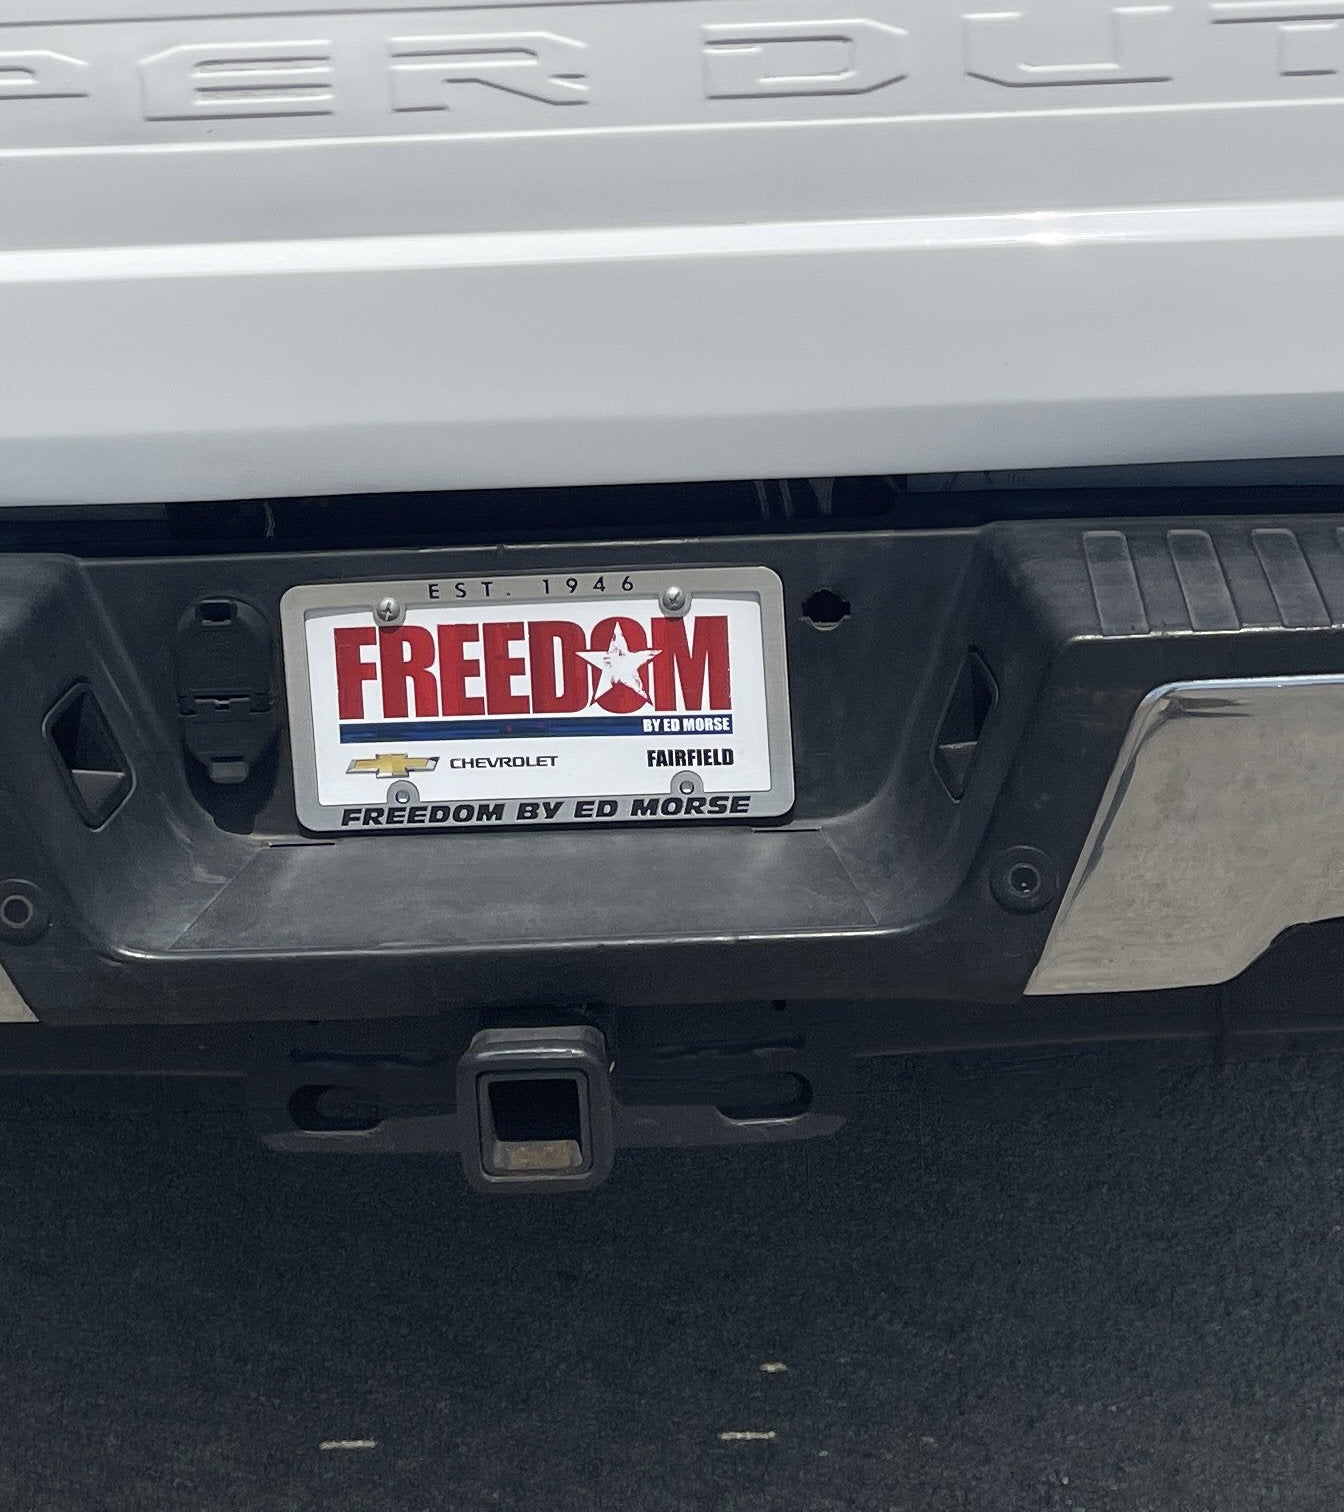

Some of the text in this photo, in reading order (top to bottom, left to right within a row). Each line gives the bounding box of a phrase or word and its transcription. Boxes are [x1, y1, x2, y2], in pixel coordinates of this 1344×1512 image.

[428, 575, 636, 600] EST. 1946
[333, 614, 733, 720] FREEDOM
[642, 716, 731, 733] BY ED MORSE
[449, 754, 559, 770] CHEVROLET
[647, 748, 735, 769] FAIRFIELD
[340, 794, 752, 827] FREEDOM BY ED MORSE
